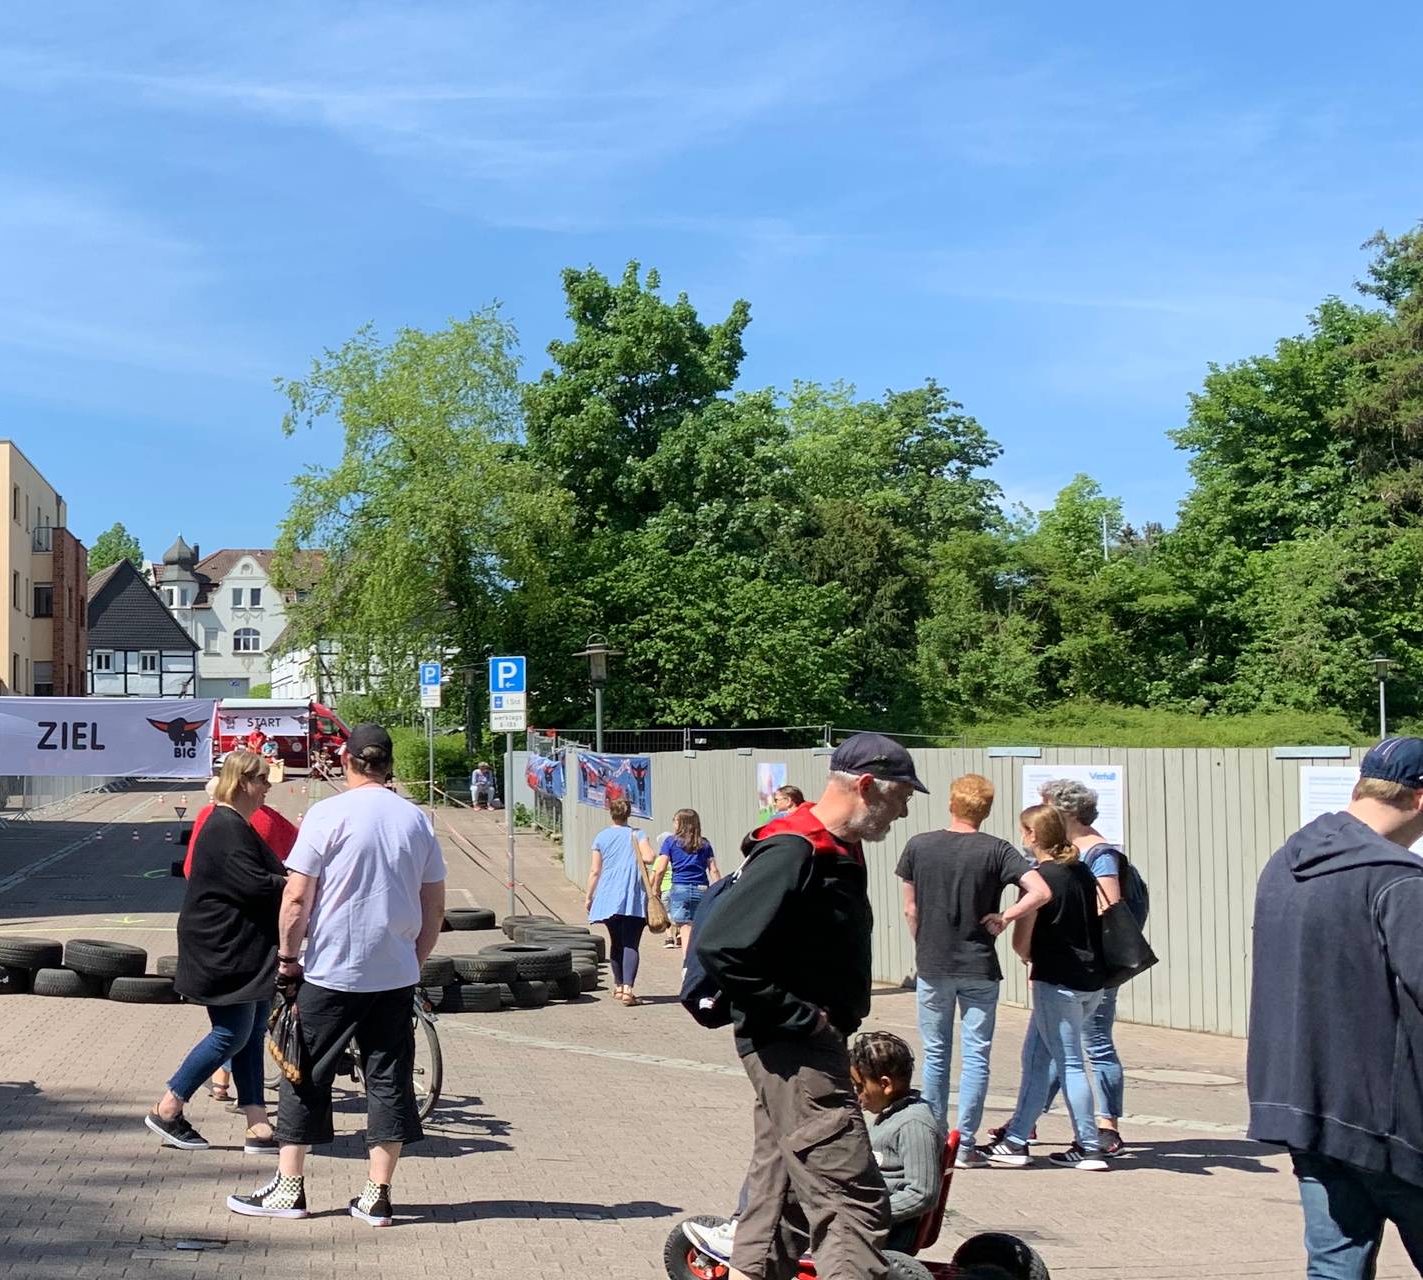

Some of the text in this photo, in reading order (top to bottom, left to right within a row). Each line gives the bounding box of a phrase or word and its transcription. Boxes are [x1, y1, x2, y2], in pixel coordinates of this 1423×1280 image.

[425, 667, 436, 684] P
[498, 662, 518, 689] P
[247, 717, 282, 728] START
[37, 721, 106, 751] ZIEL
[173, 746, 197, 759] BIG
